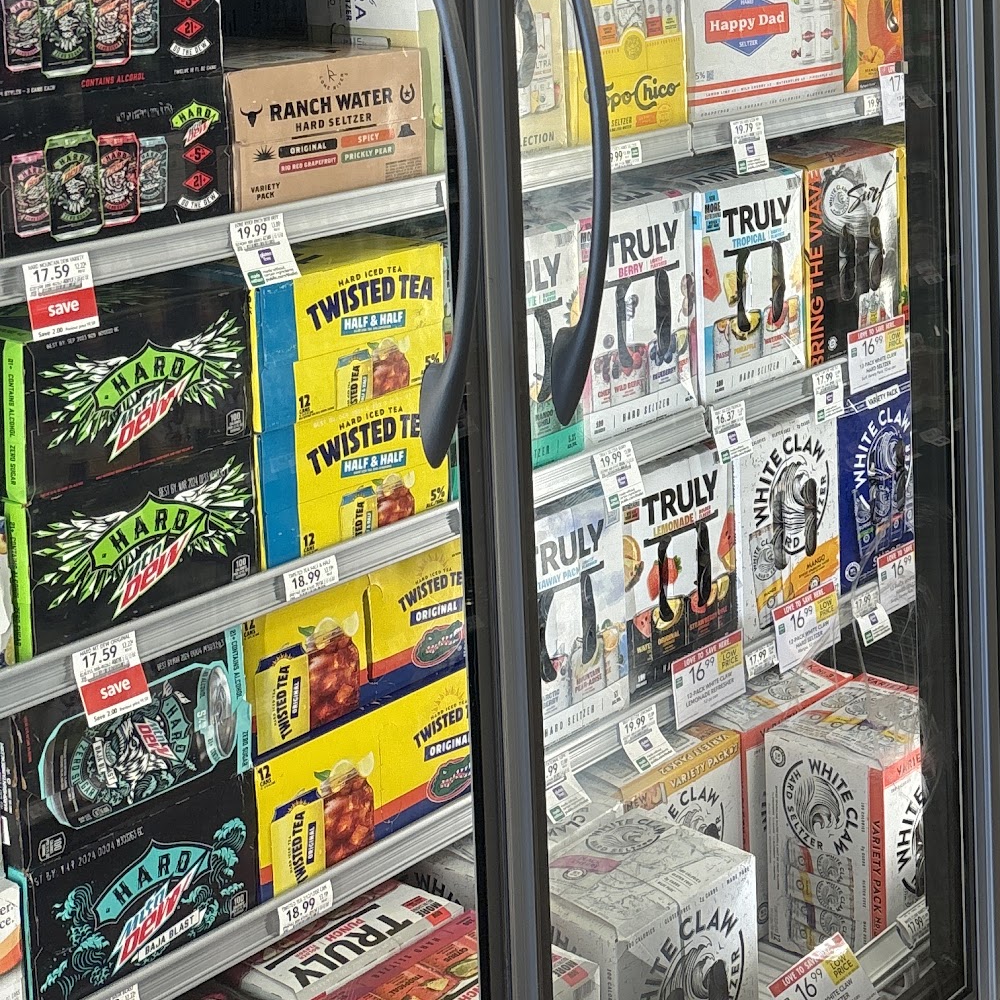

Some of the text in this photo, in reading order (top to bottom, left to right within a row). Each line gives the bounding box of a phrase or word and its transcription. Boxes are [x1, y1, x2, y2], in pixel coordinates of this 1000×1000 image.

[709, 12, 785, 36] Happy Dad
[739, 39, 758, 48] SELTZER
[81, 73, 145, 88] CONTAINS ALCOHOL
[635, 75, 681, 110] Chico
[270, 88, 393, 121] RANCH WATER
[296, 113, 372, 132] HARD SELTZER
[611, 116, 632, 128] SELTZER
[735, 122, 754, 134] 19.79
[290, 142, 326, 154] ORIGINAL
[358, 133, 379, 143] SPICY
[304, 158, 336, 168] GRAPEFRUIT
[345, 147, 392, 160] PRICKLY PEAR
[251, 182, 280, 193] VARIETY
[257, 192, 275, 200] PACK
[846, 171, 892, 215] Surf
[723, 194, 792, 238] TRULY
[237, 224, 268, 242] 19.99
[732, 231, 766, 250] TROPICAL
[607, 218, 679, 269] TRULY
[33, 264, 70, 283] 17.59
[338, 265, 403, 287] HARD ICED TEA
[618, 261, 643, 279] BERRY
[808, 170, 825, 366] BRING THE WAVE
[48, 300, 80, 317] save
[305, 274, 433, 332] TWISTED TEA
[343, 311, 404, 331] HALF HALF
[38, 330, 50, 338] Save
[110, 355, 186, 394] HARD
[816, 372, 834, 385] 17.99
[298, 394, 311, 409] 12
[716, 410, 735, 425] 16.37
[306, 418, 397, 476] TWISTED
[852, 407, 910, 490] WHITE CLAW
[343, 452, 405, 474] HALF HALF
[600, 451, 623, 468] 19.99
[600, 452, 622, 468] 19.99
[752, 432, 825, 528] WHITE CLAW
[642, 470, 718, 527] TRULY
[653, 514, 695, 538] LEMONADE
[806, 553, 826, 570] MANGO
[291, 569, 321, 590] 18.99
[398, 574, 447, 613] TWISTED
[415, 602, 458, 622] ORIGINAL
[82, 646, 117, 668] 17.59
[100, 678, 132, 699] save
[257, 765, 272, 780] 12
[669, 763, 707, 789] VARIETY
[871, 820, 884, 913] VARIETY PACK
[112, 850, 192, 906] HARD
[144, 915, 195, 956] BAJA BLAST
[287, 913, 413, 989] TRULY
